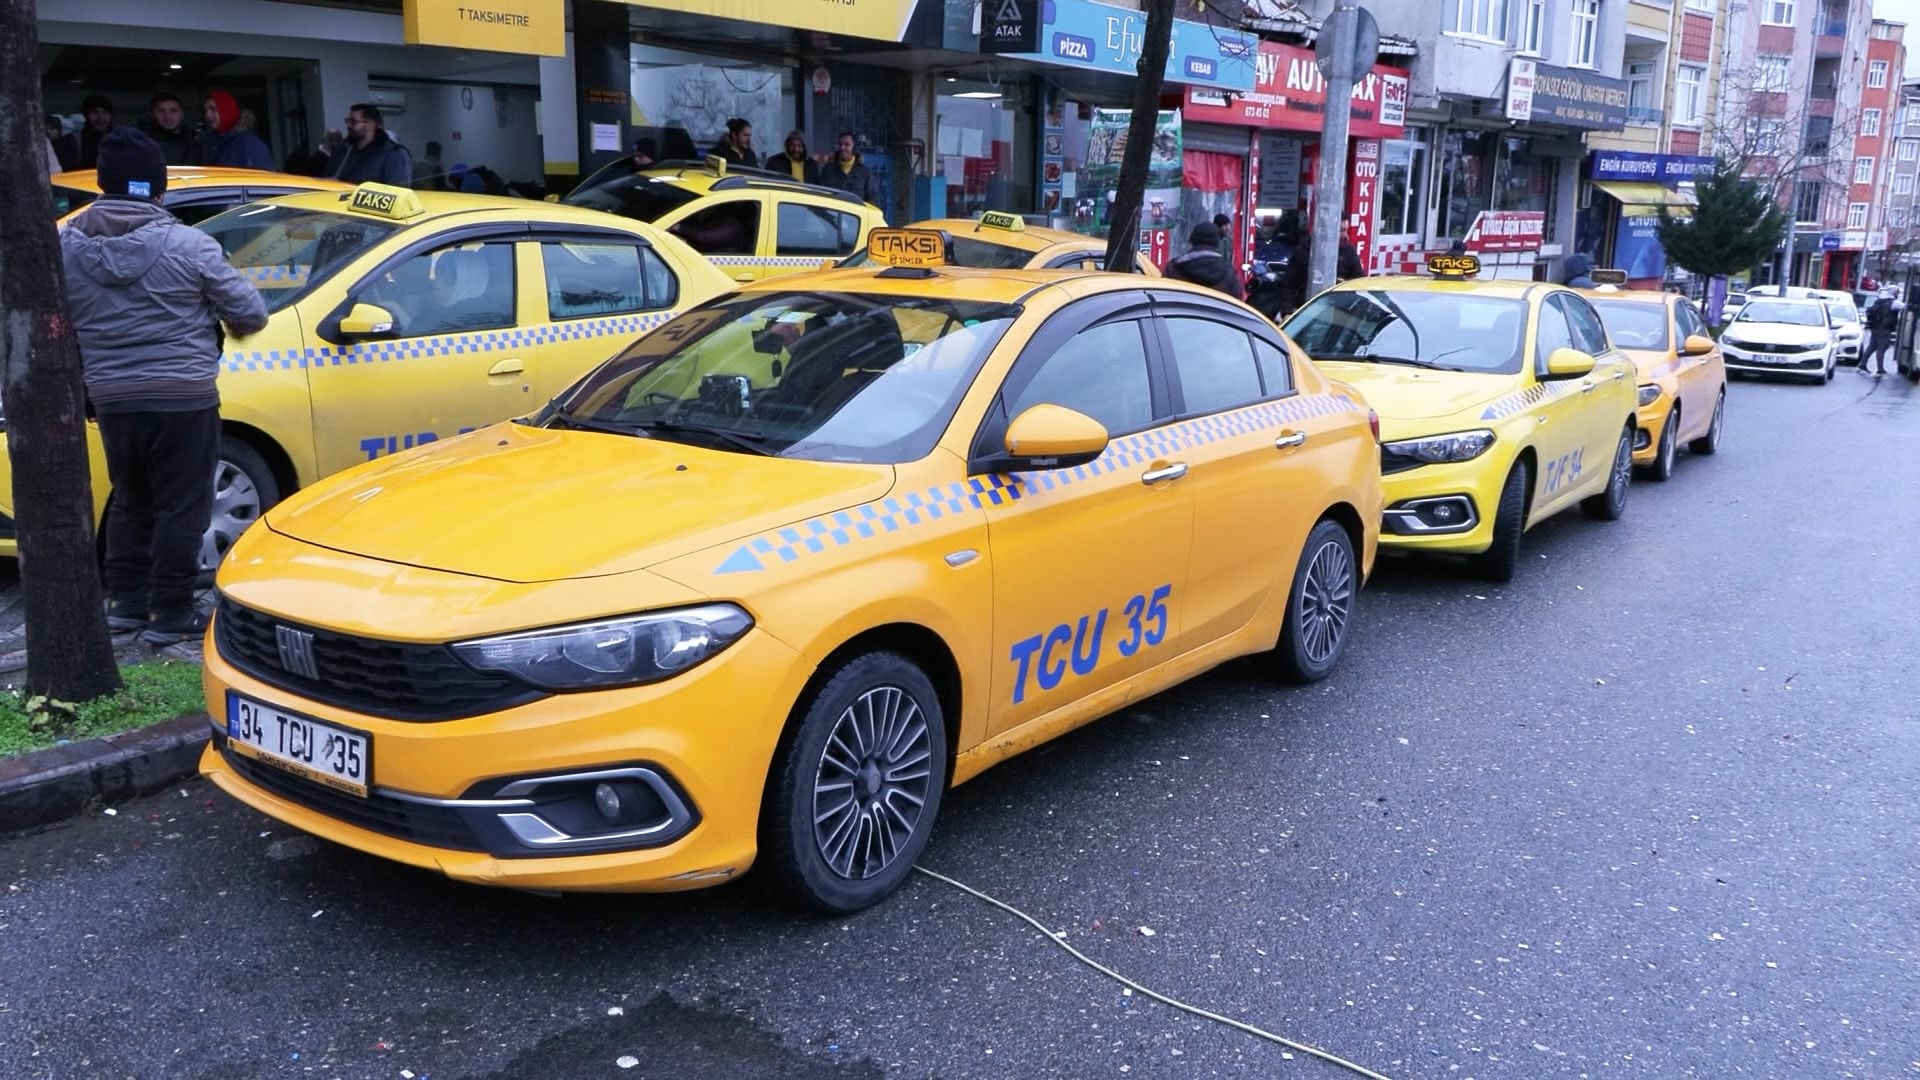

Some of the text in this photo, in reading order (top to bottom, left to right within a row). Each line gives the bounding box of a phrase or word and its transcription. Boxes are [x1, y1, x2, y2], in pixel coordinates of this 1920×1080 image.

[995, 25, 1022, 36] ATAK
[1060, 37, 1088, 58] PİZZA
[1190, 61, 1212, 75] KEBAB
[1356, 162, 1376, 177] OTO
[1600, 157, 1620, 172] ENGİN
[275, 624, 320, 681] FIAT
[1011, 584, 1172, 705] TCU 35
[241, 703, 263, 745] 34
[276, 715, 314, 763] TCU
[333, 735, 360, 779] 35
